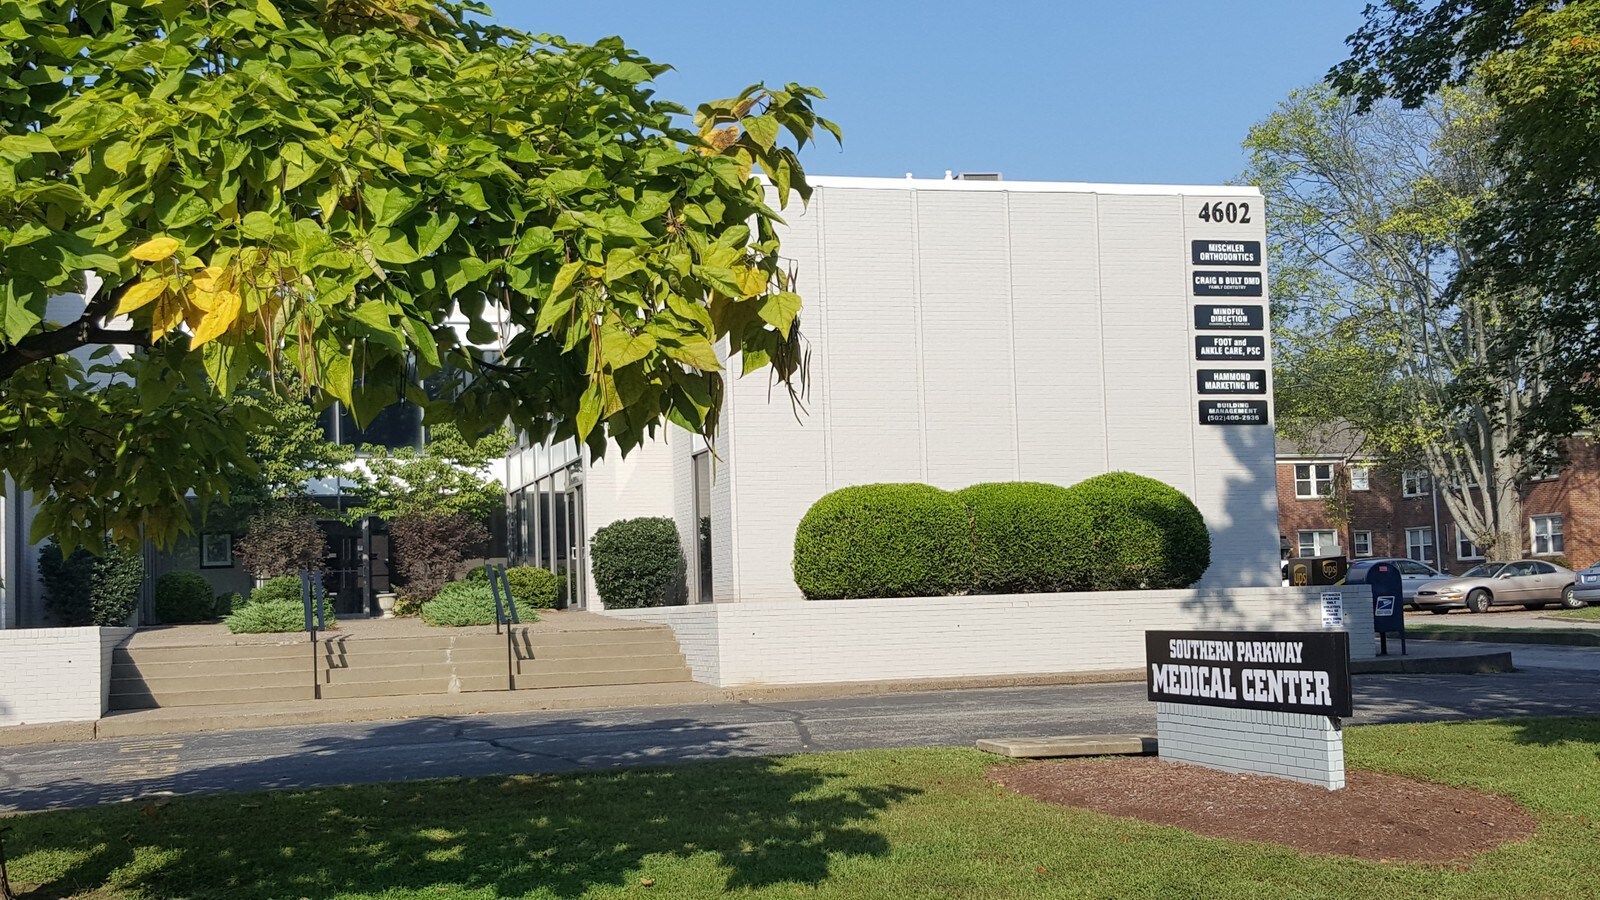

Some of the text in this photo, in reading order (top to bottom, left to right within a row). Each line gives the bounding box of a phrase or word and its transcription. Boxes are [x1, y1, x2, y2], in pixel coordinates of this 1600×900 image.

[1198, 201, 1251, 224] 4602
[1208, 243, 1245, 252] MISCHLER
[1200, 252, 1254, 261] ORTHODONTICS
[1195, 276, 1260, 285] CRAIG B BULT DMD
[1210, 315, 1248, 323] DIRECTION
[1214, 338, 1247, 346] FOOT and
[1201, 346, 1260, 356] ANKLE CARE, PSC
[1213, 372, 1251, 381] HAMMOND
[1205, 381, 1259, 390] MARKETING INC
[1169, 639, 1303, 664] SOUTHERN PARKWAY
[1152, 663, 1332, 706] MEDICAL CENTER
